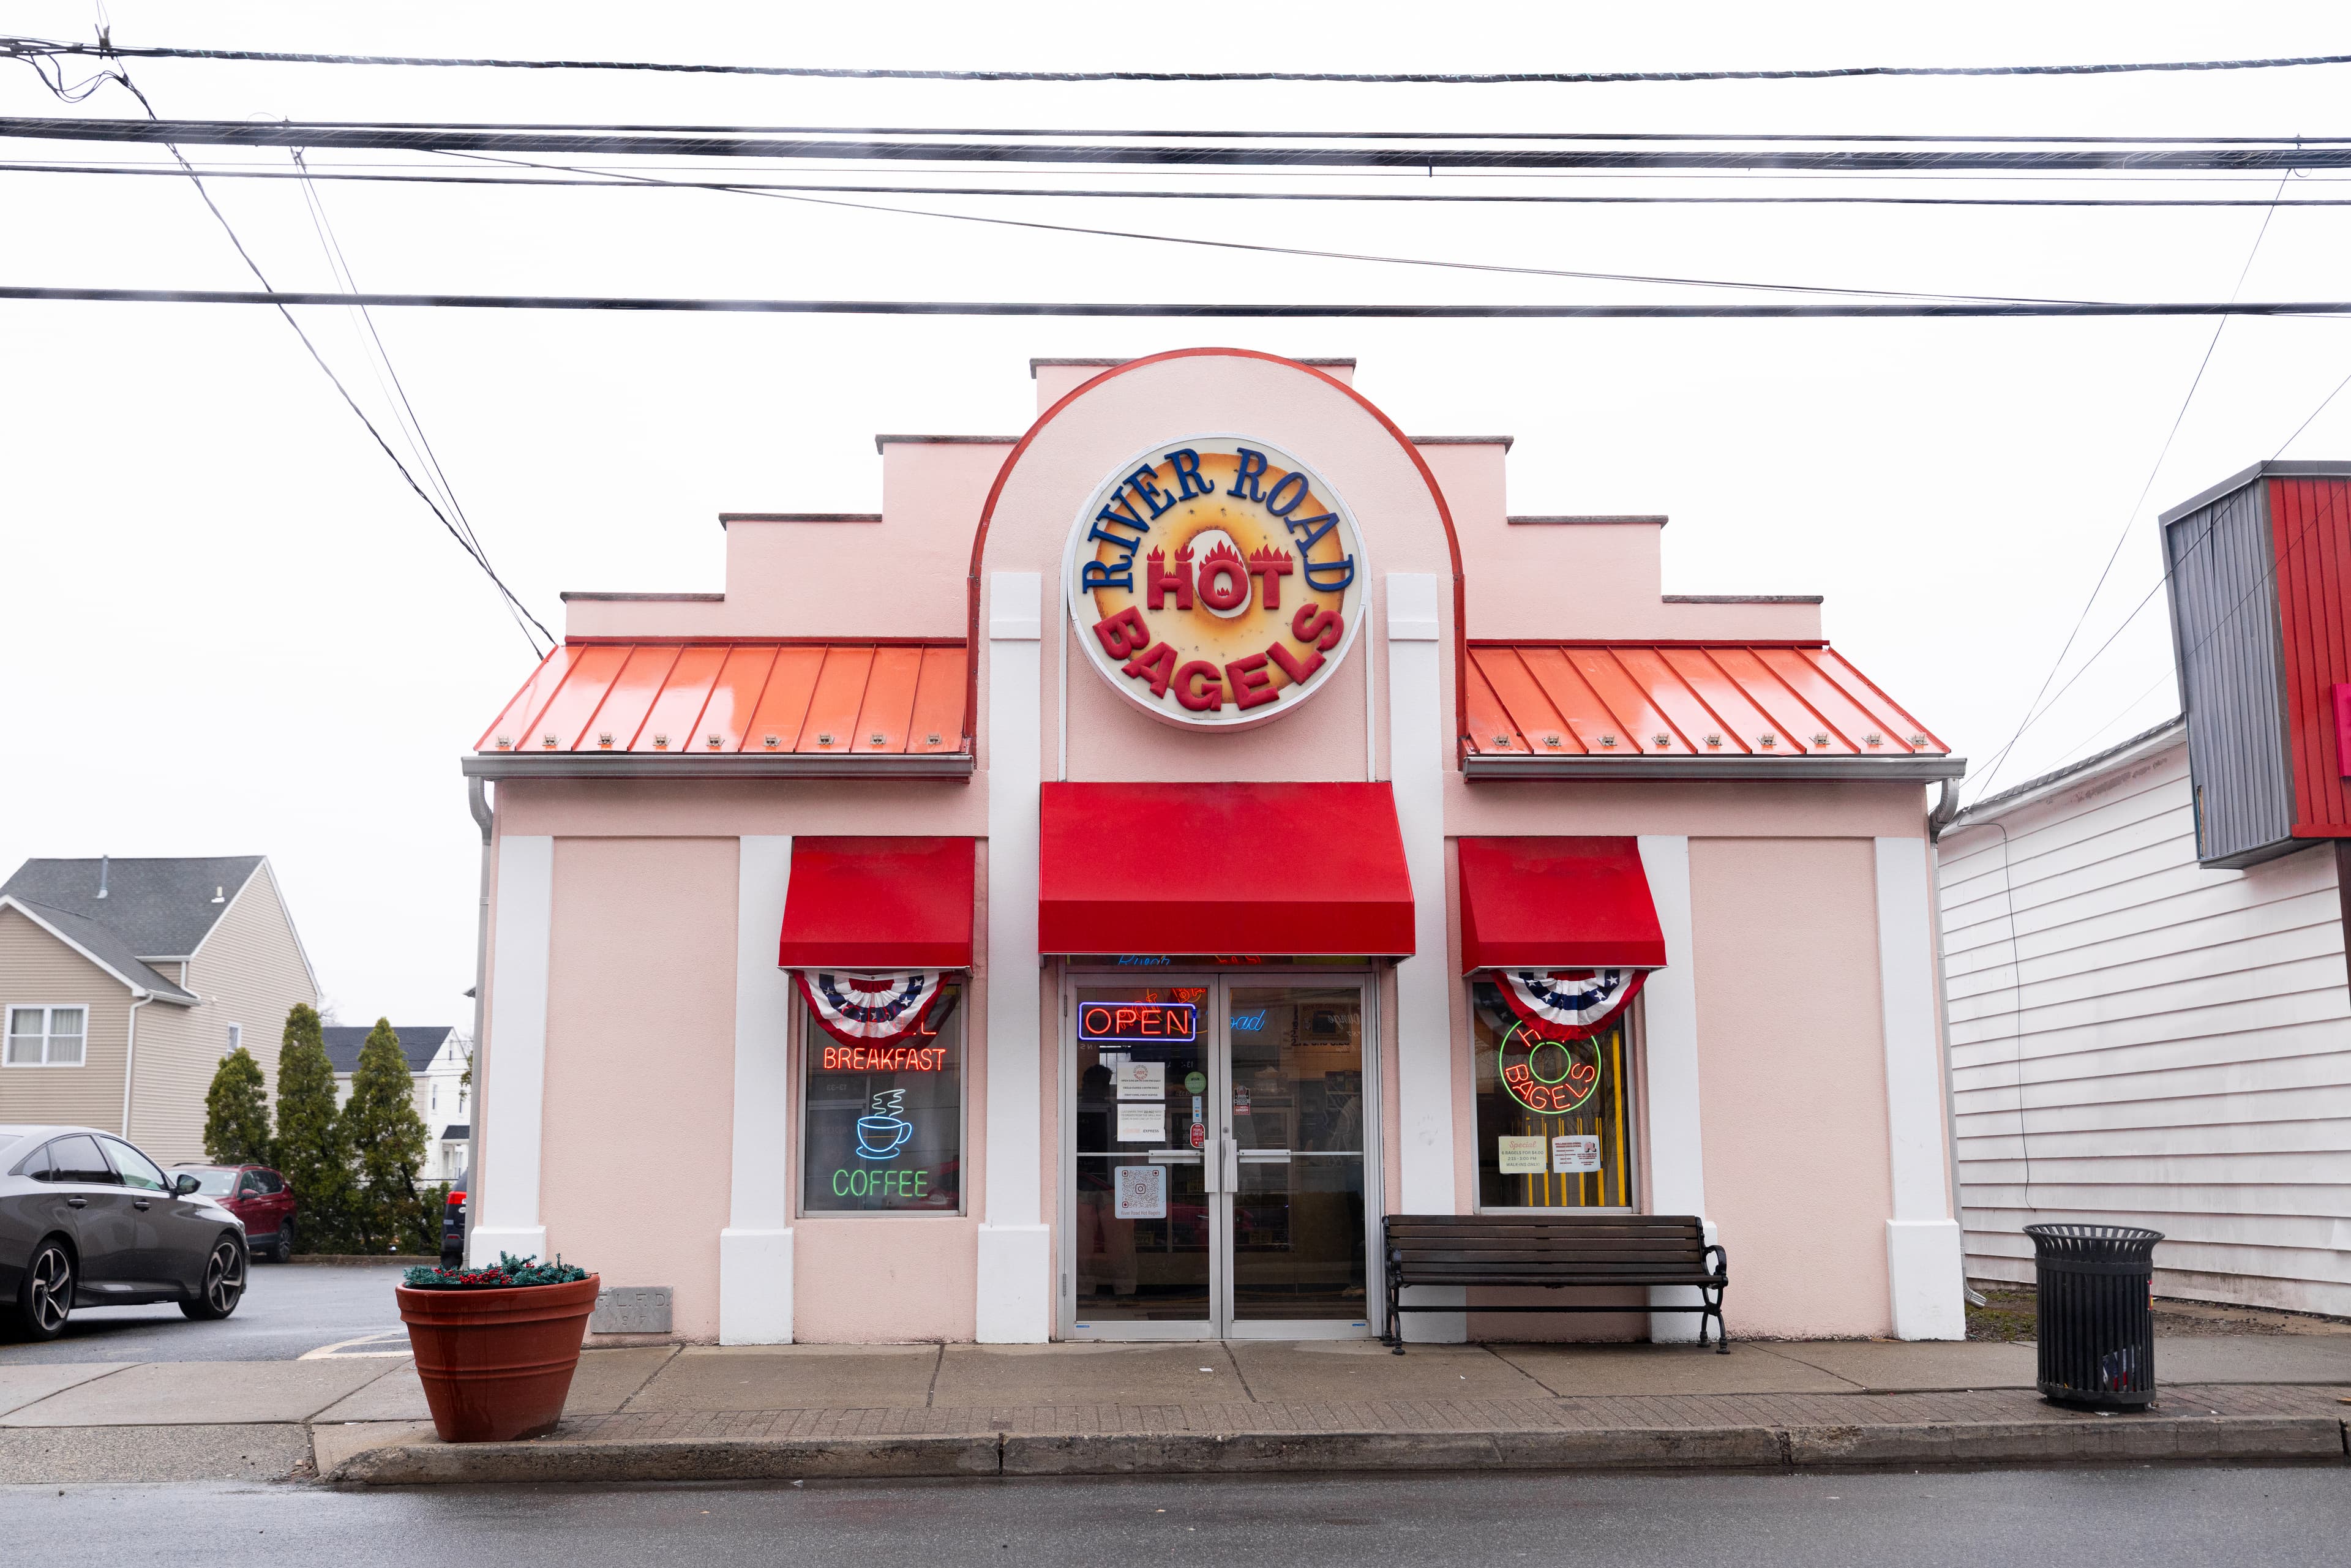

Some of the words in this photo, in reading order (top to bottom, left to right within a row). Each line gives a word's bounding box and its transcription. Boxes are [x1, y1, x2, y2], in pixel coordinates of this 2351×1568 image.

[1082, 448, 1215, 594] RIVER
[1227, 447, 1354, 592] ROAD
[1147, 542, 1293, 610] HOT
[1093, 604, 1344, 711] BAGELS
[1086, 1008, 1188, 1034] OPEN
[1229, 1010, 1266, 1031] oad
[823, 1047, 947, 1071] BREAKFAST
[1505, 1063, 1595, 1109] BAGELS
[1509, 1141, 1537, 1150] Special
[833, 1169, 928, 1196] COFFEE
